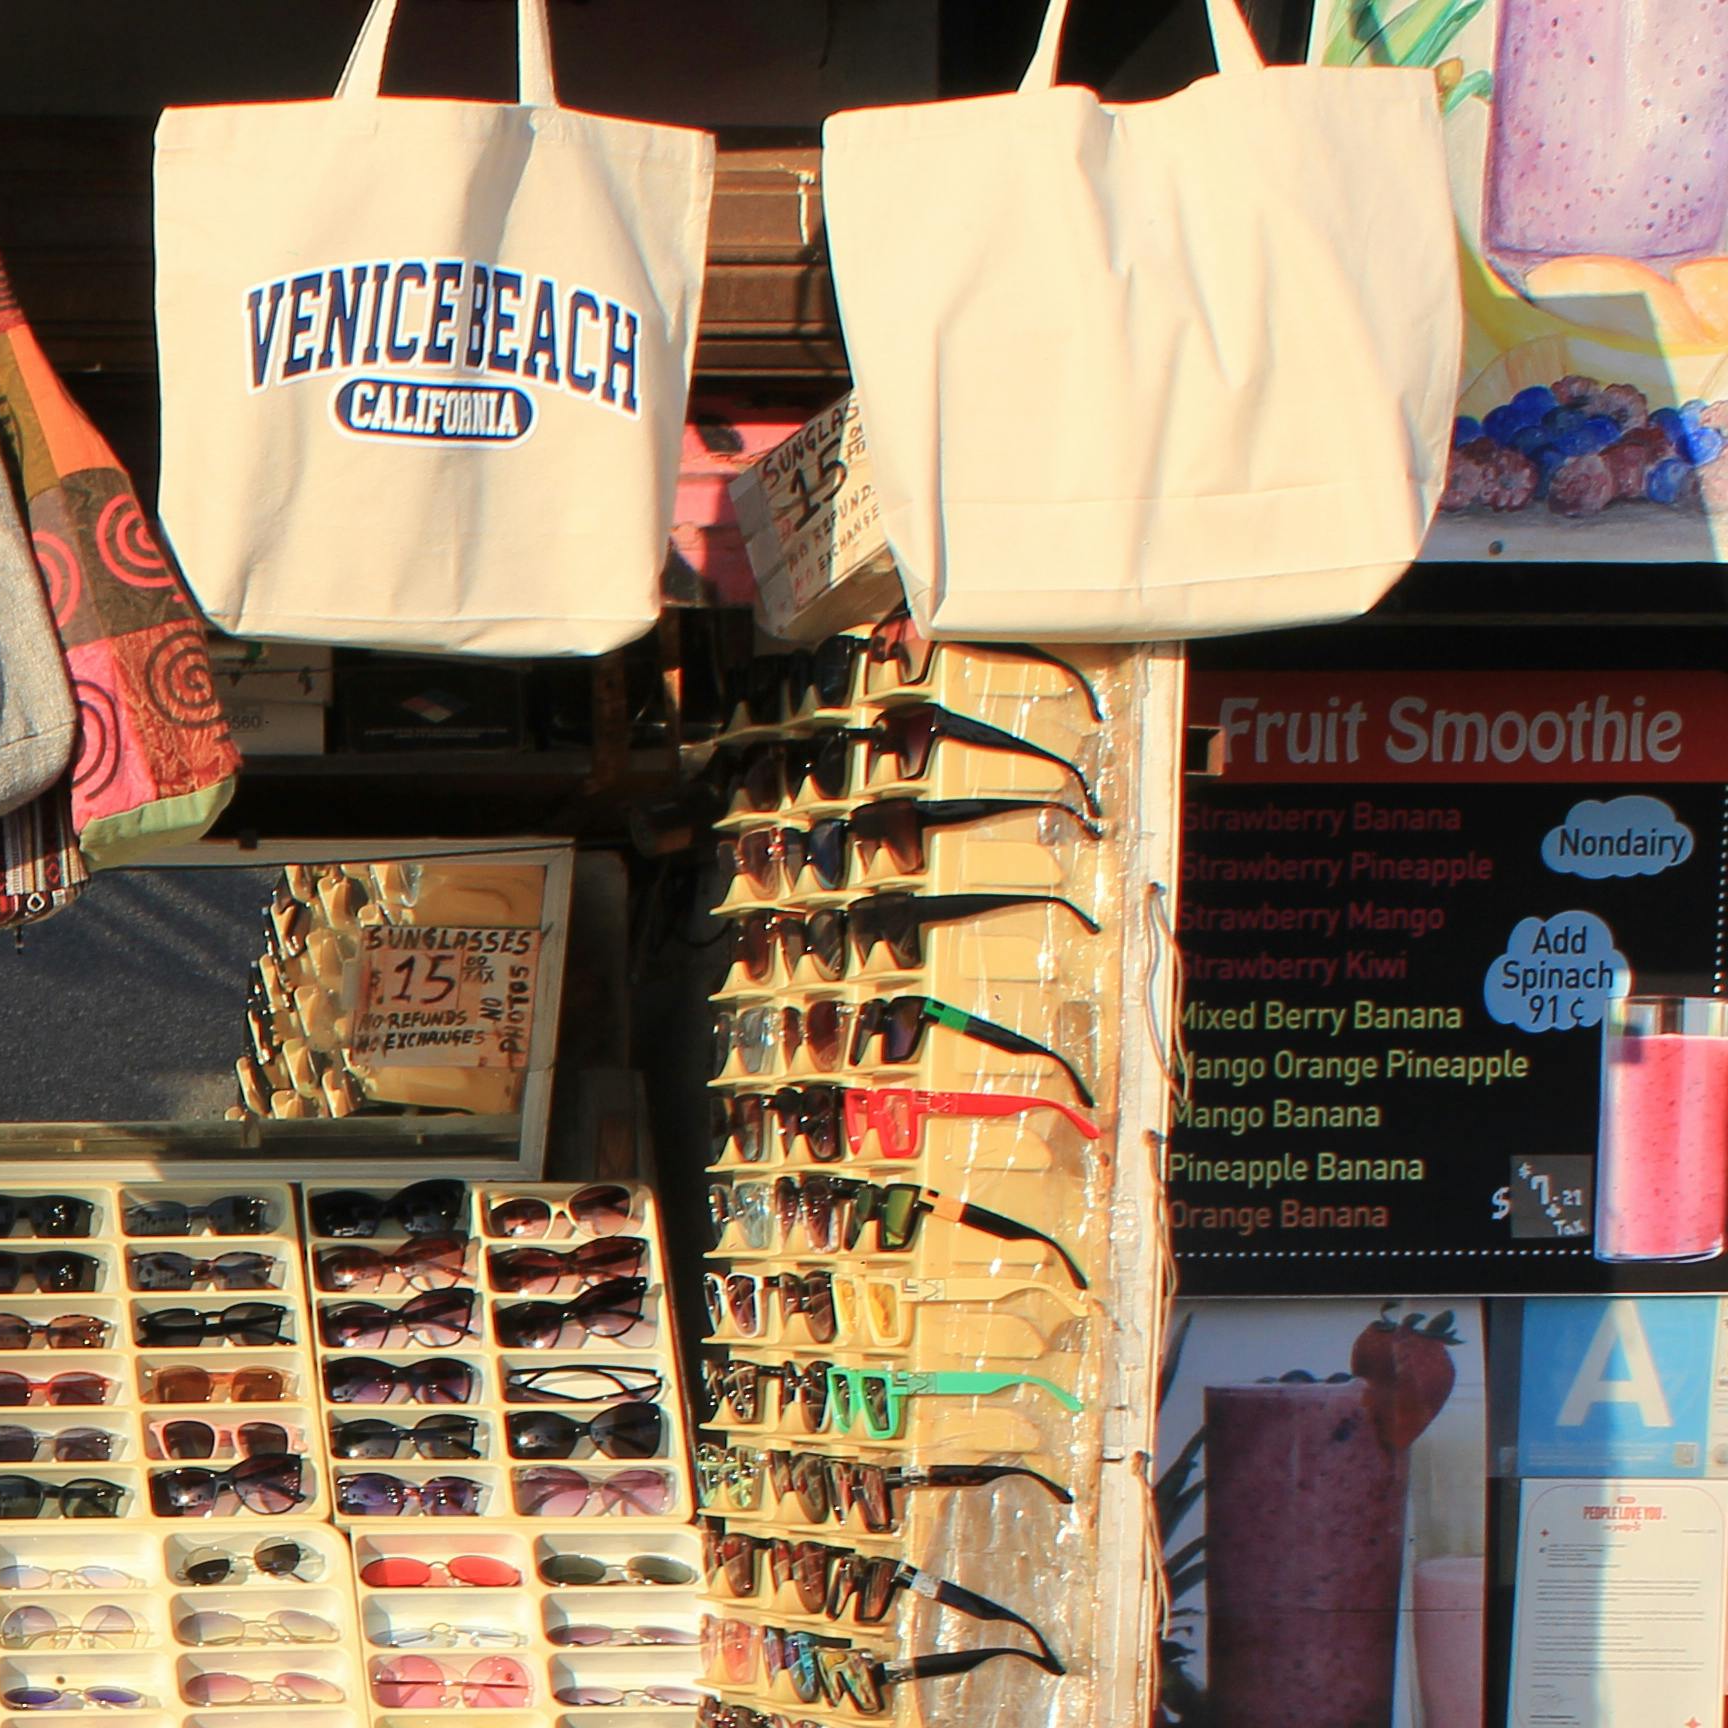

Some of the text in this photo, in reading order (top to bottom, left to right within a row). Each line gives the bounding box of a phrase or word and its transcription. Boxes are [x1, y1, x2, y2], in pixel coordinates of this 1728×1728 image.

[247, 259, 642, 418] VENICE BEACH
[350, 381, 519, 437] CALIFORNIA
[788, 435, 848, 532] 15
[814, 483, 877, 541] REFUND
[1218, 694, 1684, 765] Fruit Smoothie
[1183, 801, 1462, 839] Strawberry Banana
[1558, 827, 1688, 864] Nondairy
[1181, 850, 1494, 889] Strawberry Pineapple
[1180, 900, 1445, 938] Strawberry Mango
[364, 926, 532, 956] SUNGLASSES
[1531, 925, 1588, 955] Add
[391, 954, 457, 1005] 15
[1181, 949, 1408, 988] Strawberry Kiwi
[1502, 959, 1614, 998] Spinach
[388, 1009, 468, 1030] REFUNDS
[1178, 1000, 1463, 1036] Mixed Berry Banana
[1528, 994, 1557, 1024] 91
[383, 1029, 486, 1055] EXCHANGES
[1171, 1048, 1530, 1088] Mango Orange Pineapple
[1171, 1098, 1381, 1136] Mango Banana
[1168, 1152, 1425, 1190] Pineapple Banana
[1170, 1199, 1389, 1236] Orange Banana
[1490, 1185, 1511, 1221] $
[1555, 1298, 1675, 1428] A
[1619, 1505, 1642, 1521] LOVE
